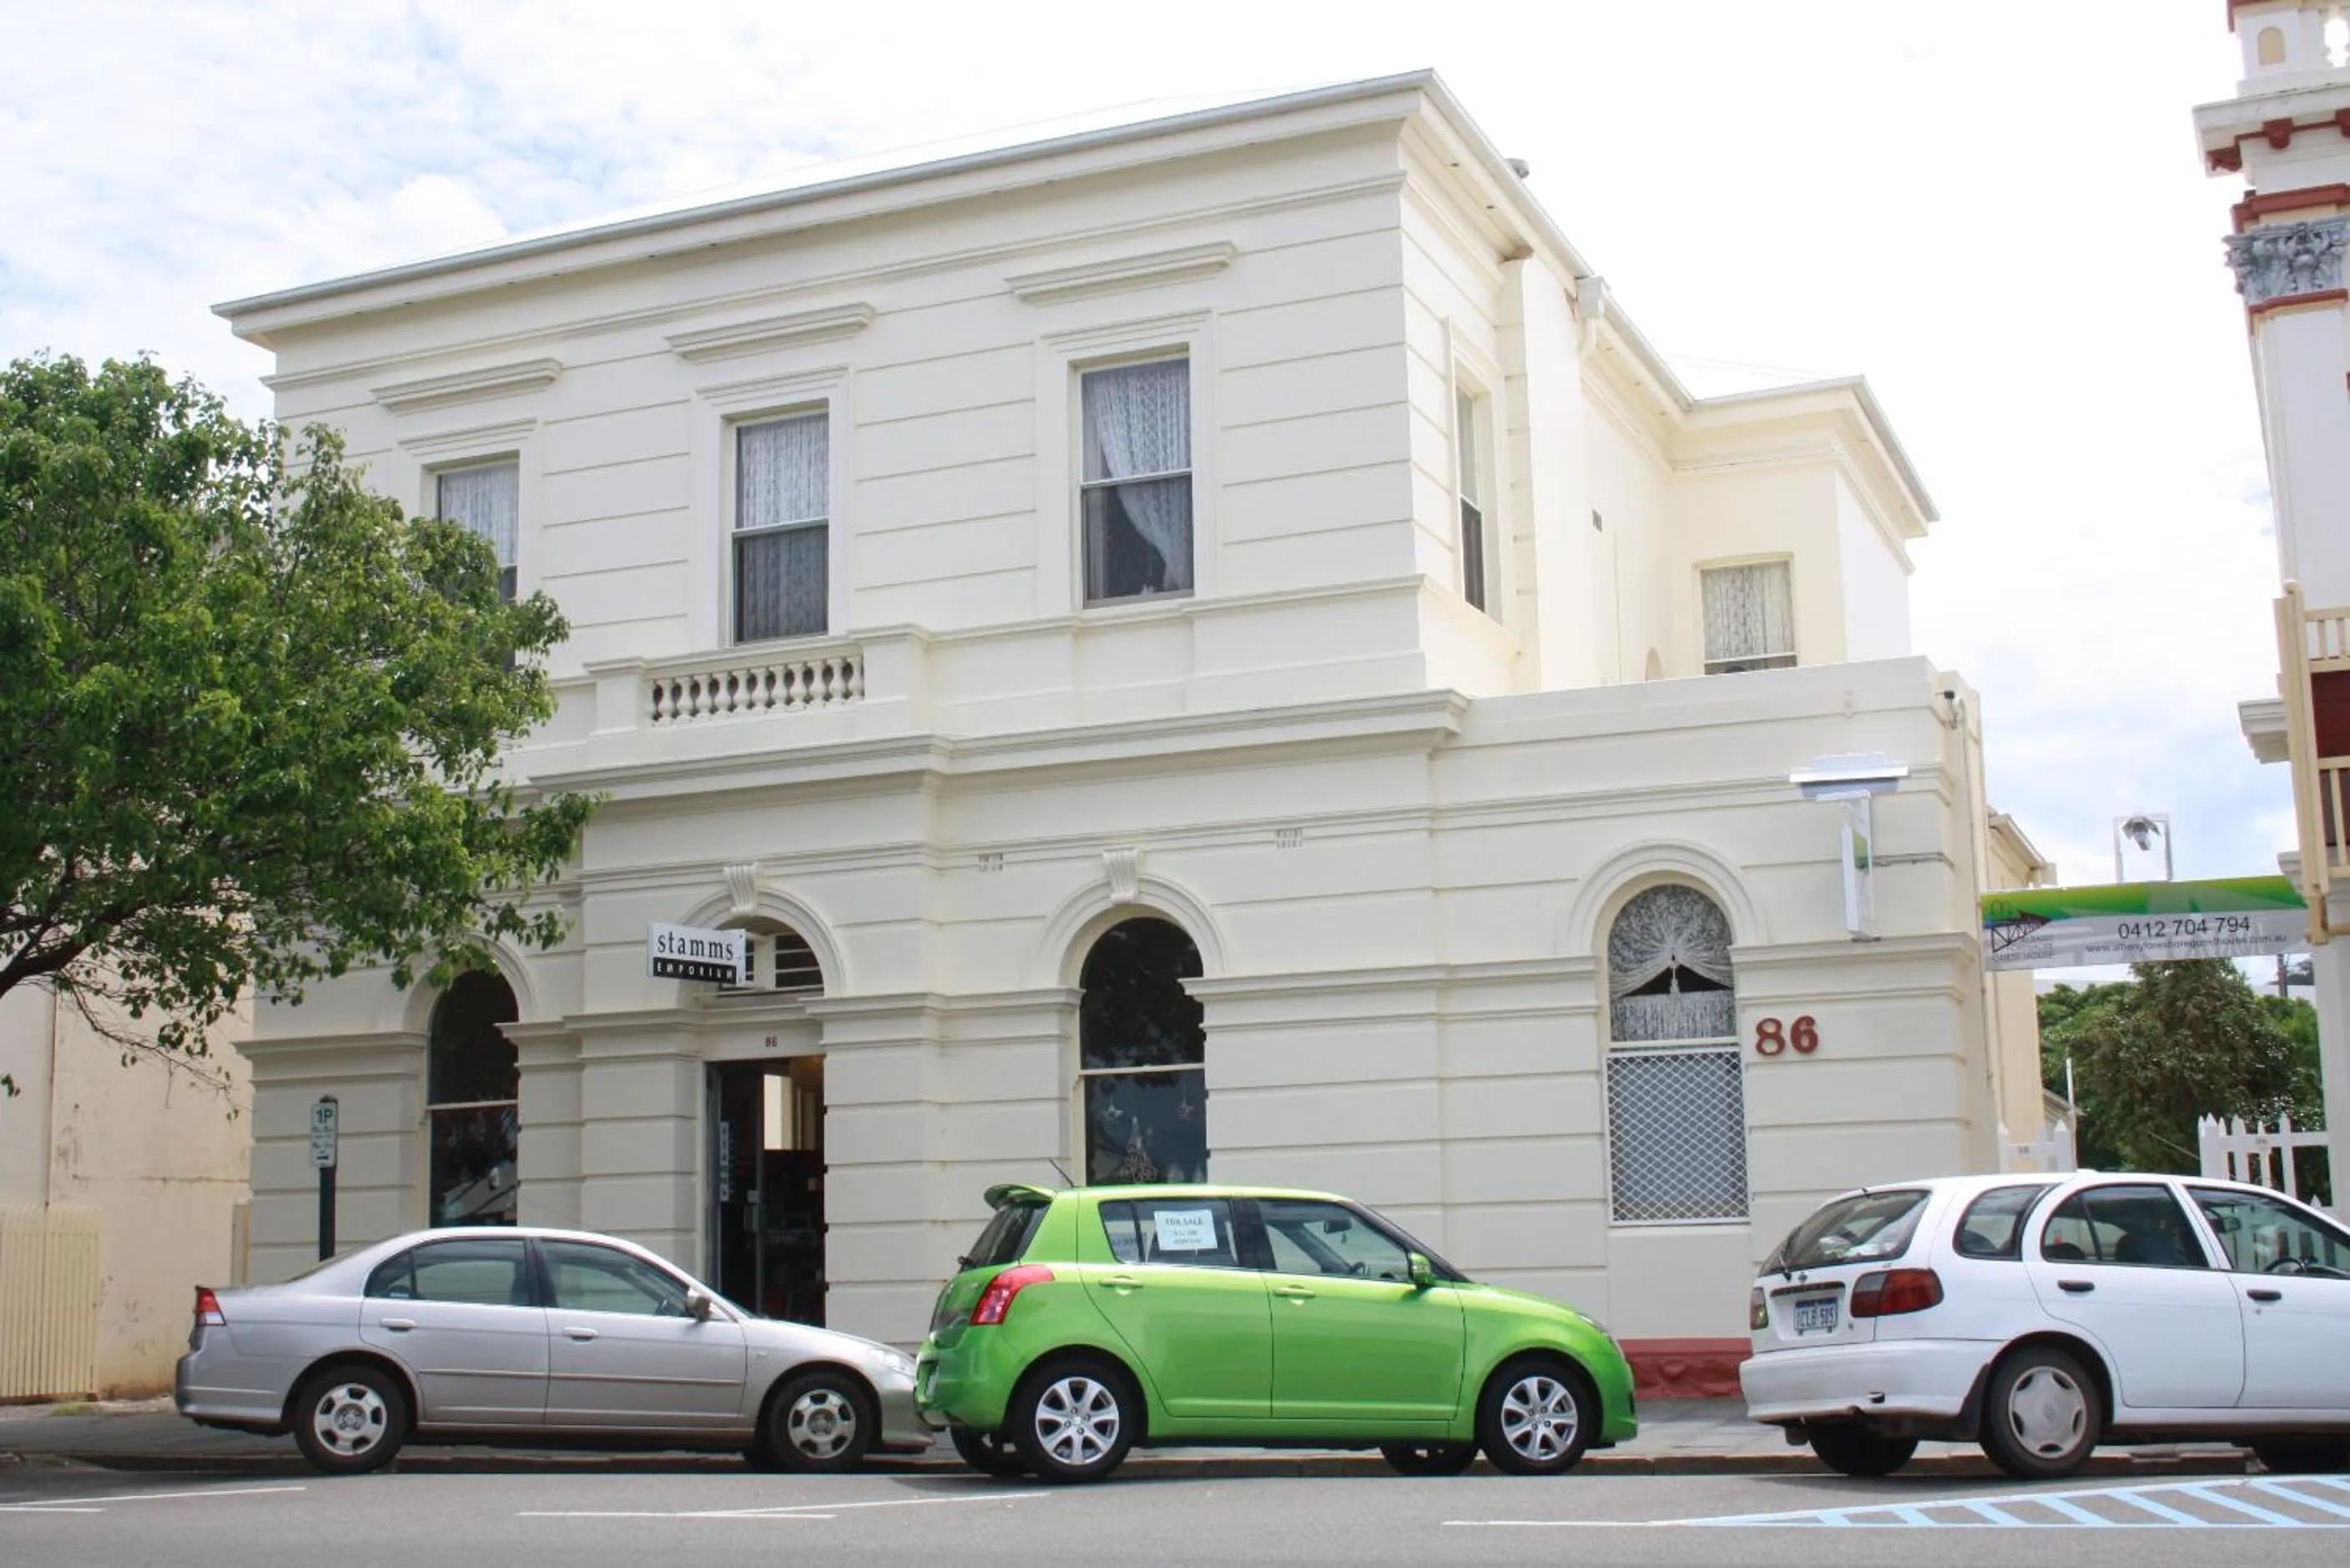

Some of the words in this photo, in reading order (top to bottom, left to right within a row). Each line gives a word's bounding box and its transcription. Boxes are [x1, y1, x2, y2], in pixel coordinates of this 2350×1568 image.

[2118, 920, 2166, 939] 0412
[2172, 919, 2208, 935] 704
[2214, 915, 2251, 934] 794
[657, 930, 734, 961] stamms
[657, 962, 734, 980] EMPORIUM
[764, 1036, 778, 1047] 86
[1755, 1015, 1818, 1056] 86
[315, 1108, 333, 1124] 1P
